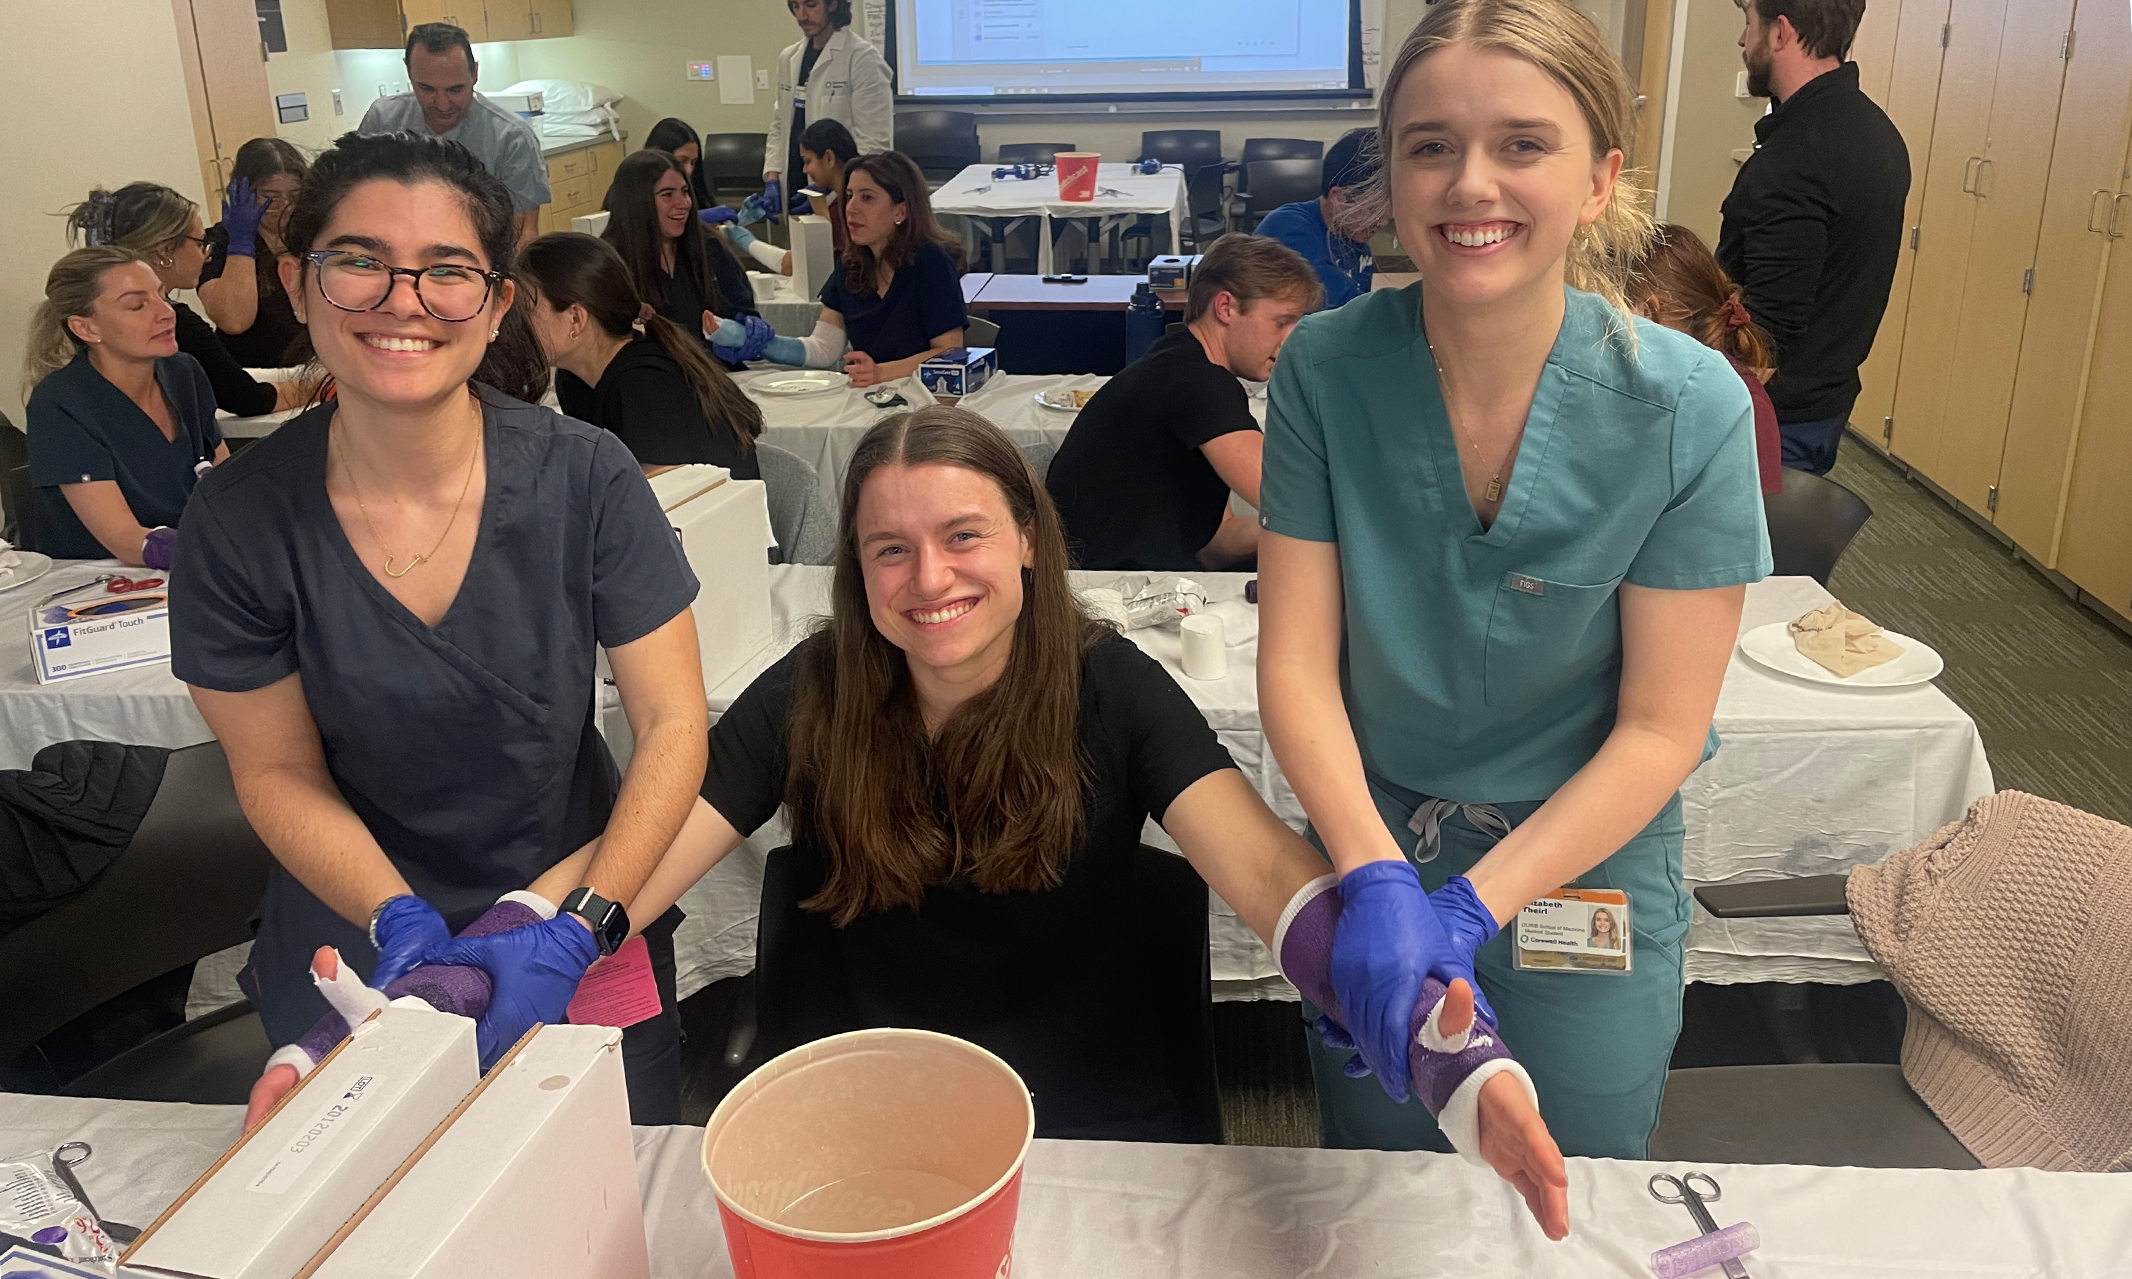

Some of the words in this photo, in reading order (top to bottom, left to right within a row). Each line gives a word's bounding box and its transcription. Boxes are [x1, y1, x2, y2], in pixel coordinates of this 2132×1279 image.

[1520, 580, 1534, 589] FIGS
[118, 618, 144, 628] Touch
[52, 664, 67, 673] 300
[290, 1104, 348, 1154] 20120203
